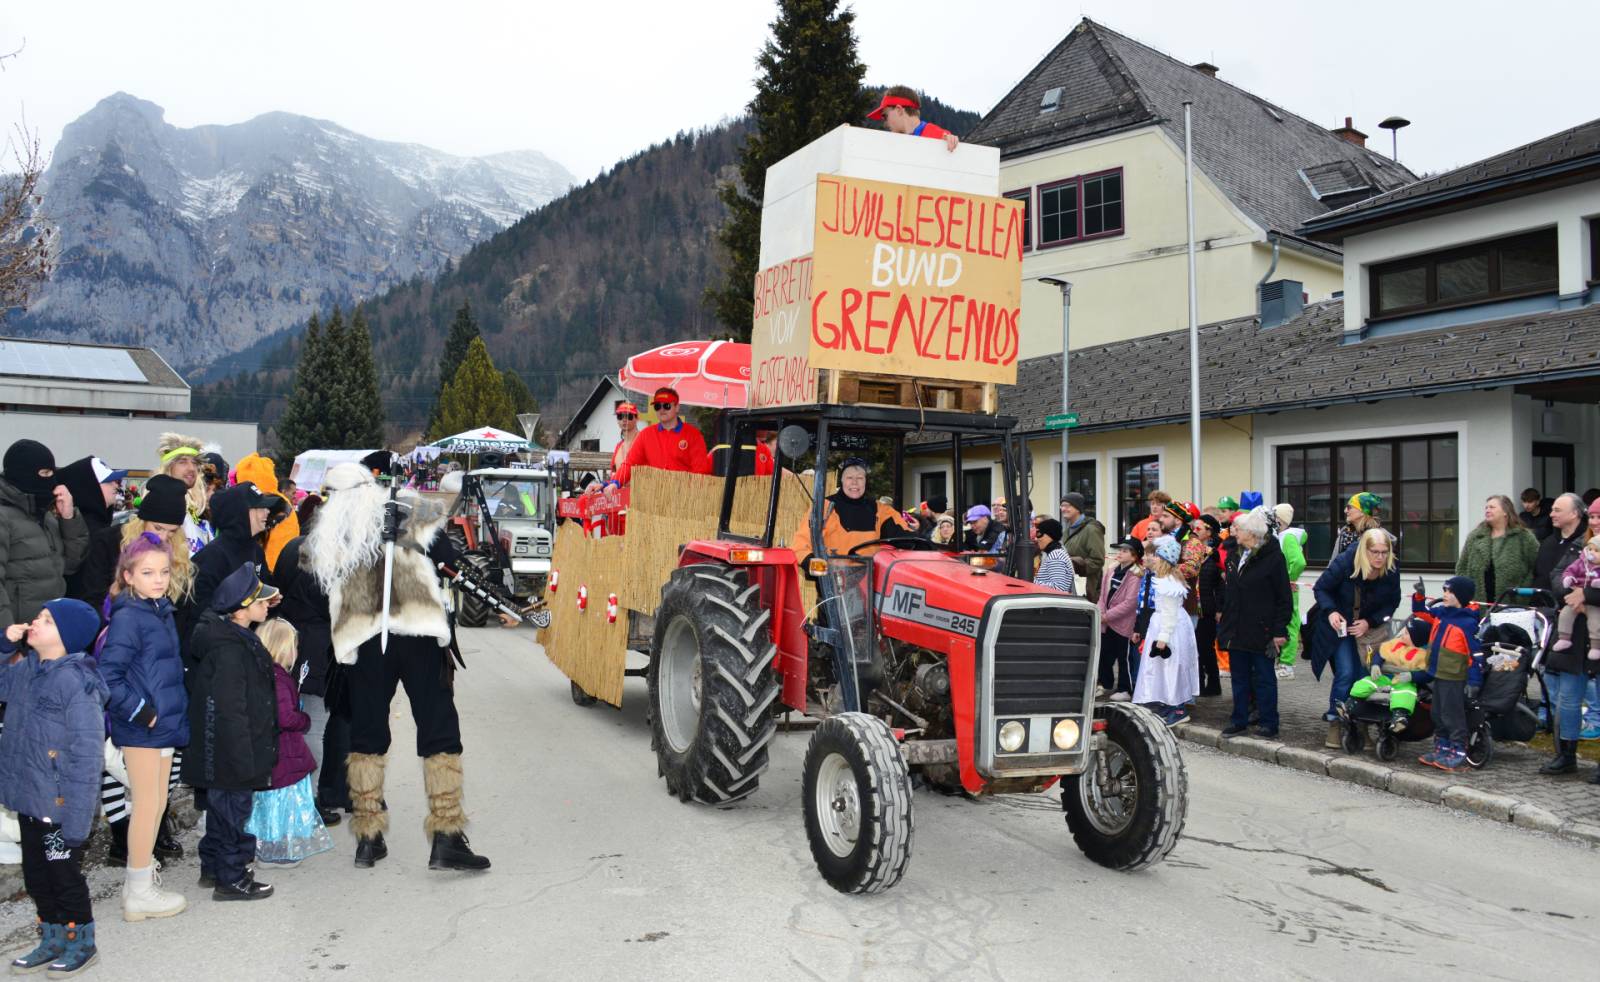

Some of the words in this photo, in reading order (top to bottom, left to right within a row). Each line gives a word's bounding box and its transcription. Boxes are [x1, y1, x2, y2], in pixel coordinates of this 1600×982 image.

[819, 180, 1025, 262] JUNGGESELLEN
[871, 242, 962, 288] BUND
[769, 306, 800, 344] VON
[811, 288, 1020, 366] GRENZENLOS
[453, 438, 529, 449] Heineken
[892, 589, 922, 615] MF
[951, 616, 975, 634] 245
